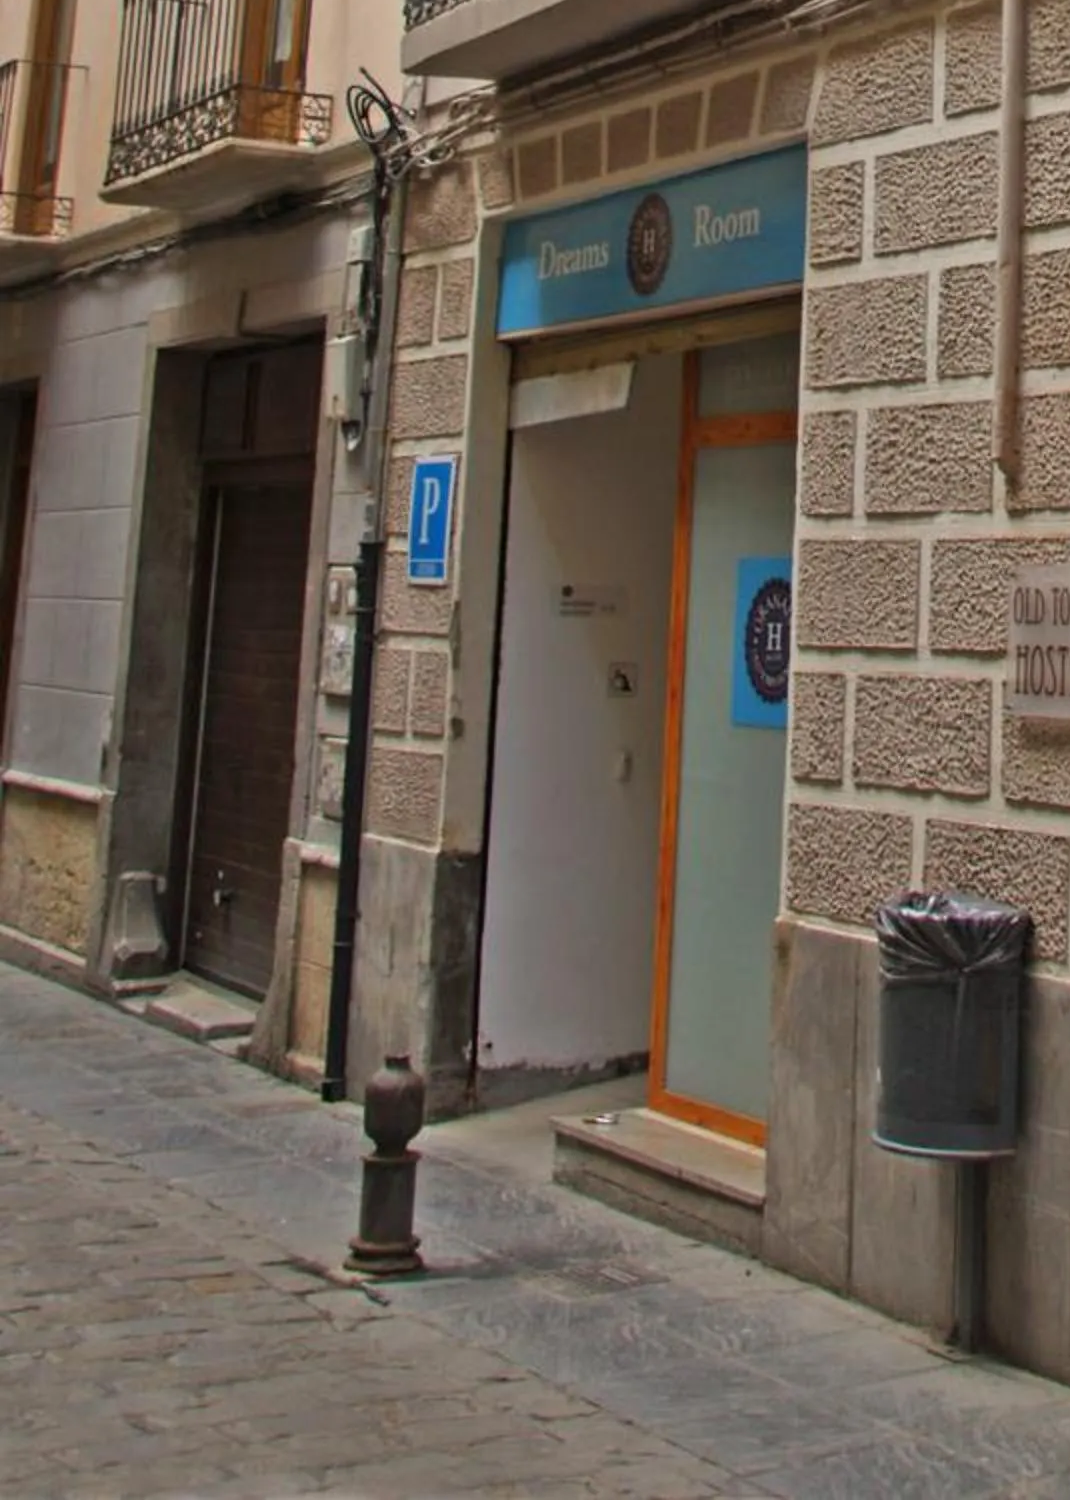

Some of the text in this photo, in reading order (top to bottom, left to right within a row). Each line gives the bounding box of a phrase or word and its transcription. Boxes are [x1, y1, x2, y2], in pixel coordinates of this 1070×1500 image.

[538, 241, 609, 279] Dreams
[693, 203, 760, 248] Room
[419, 476, 441, 545] P
[1013, 587, 1045, 625] OLD
[766, 622, 782, 651] H
